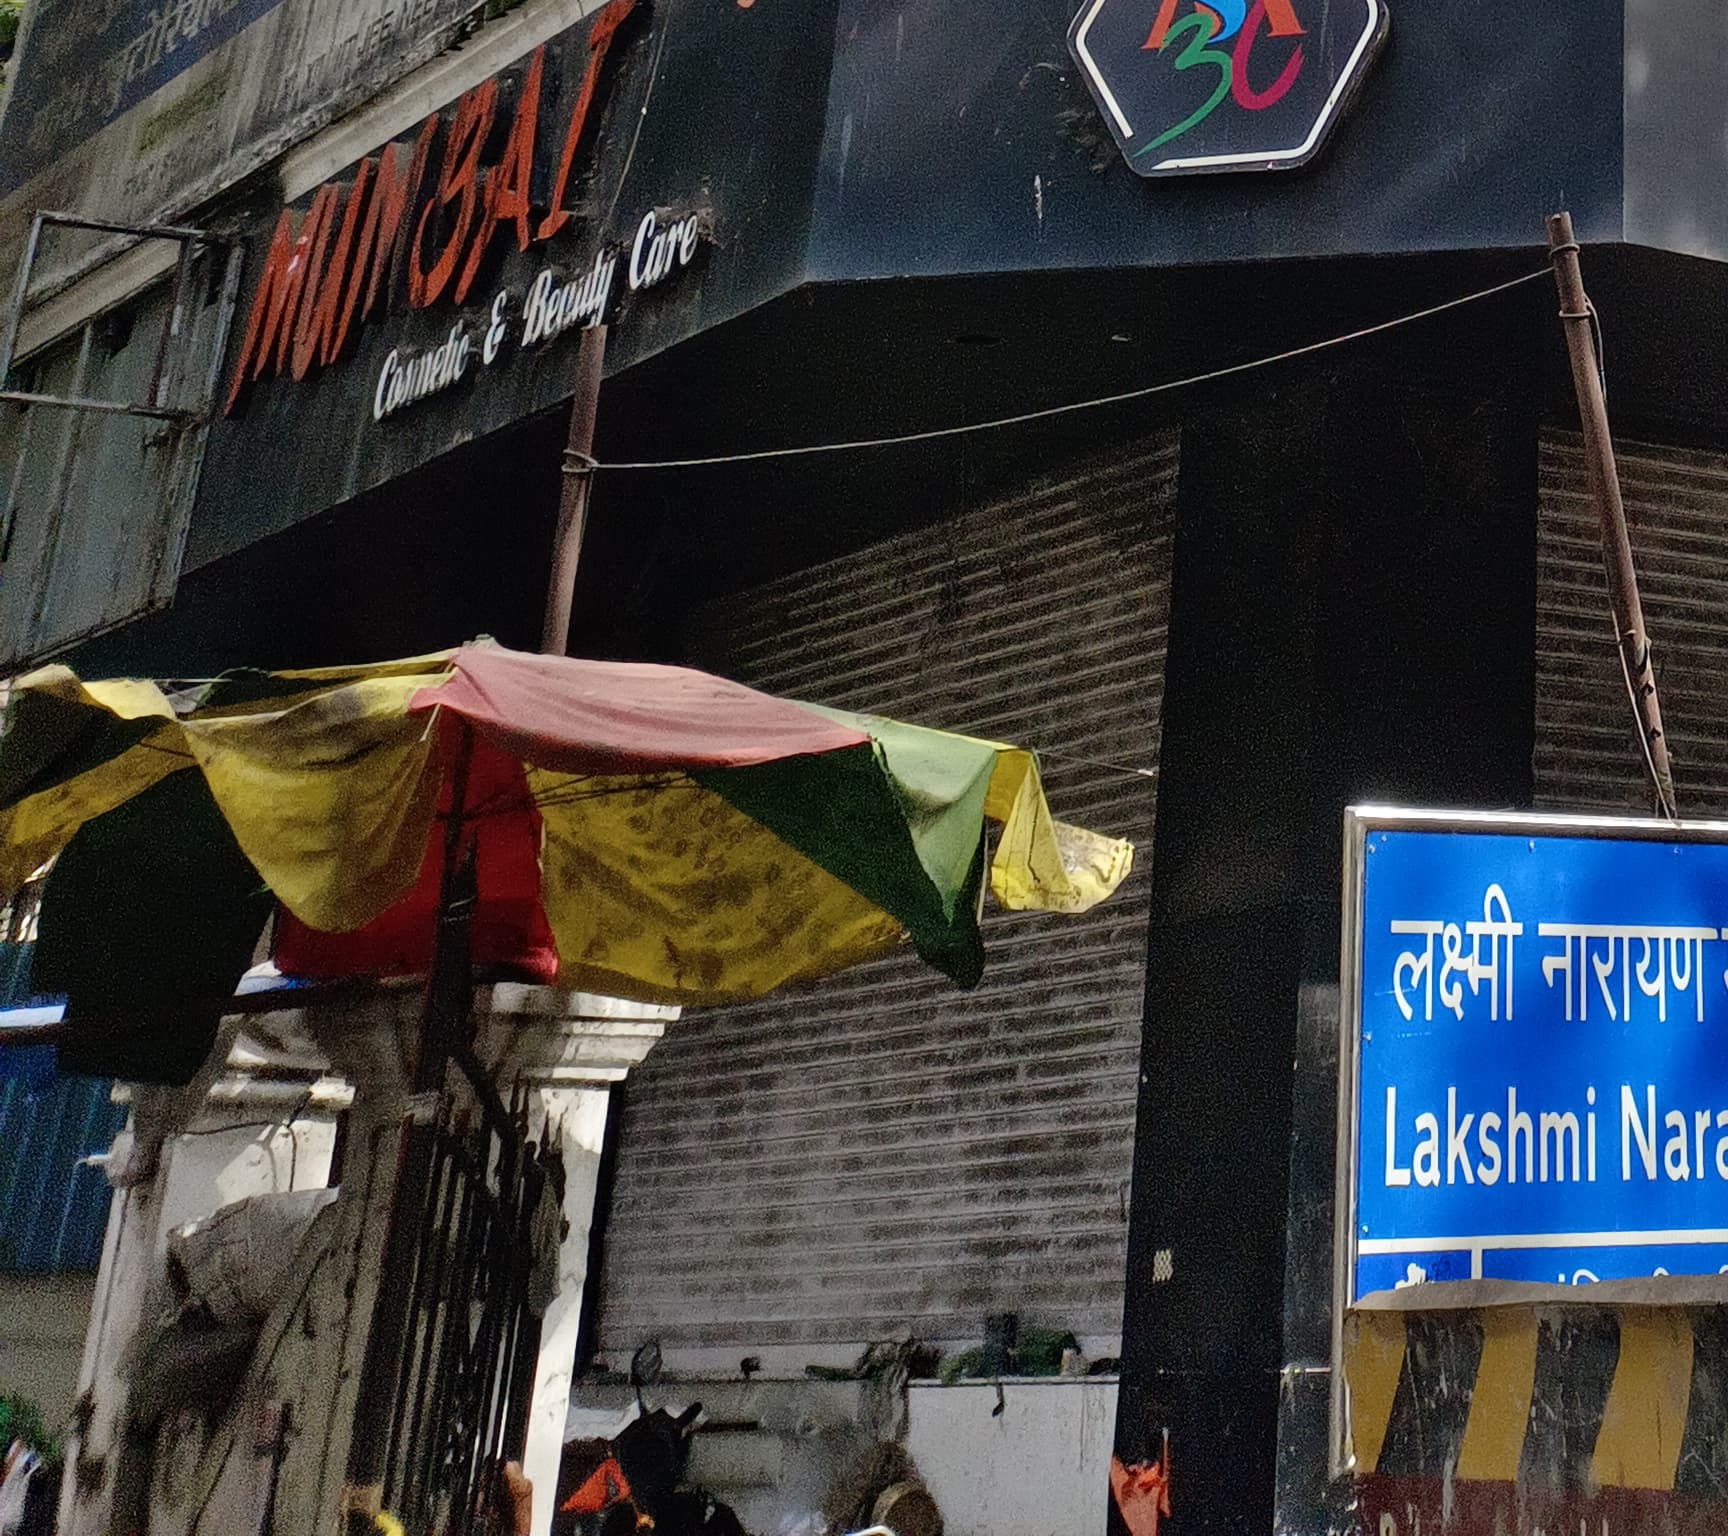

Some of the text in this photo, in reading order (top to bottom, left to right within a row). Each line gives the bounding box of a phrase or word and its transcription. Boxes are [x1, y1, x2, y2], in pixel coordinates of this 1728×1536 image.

[629, 210, 699, 291] Care
[1390, 882, 1523, 1023] लक्ष्मी
[1537, 922, 1718, 1023] नारायण
[1385, 1084, 1598, 1187] Lakshmi
